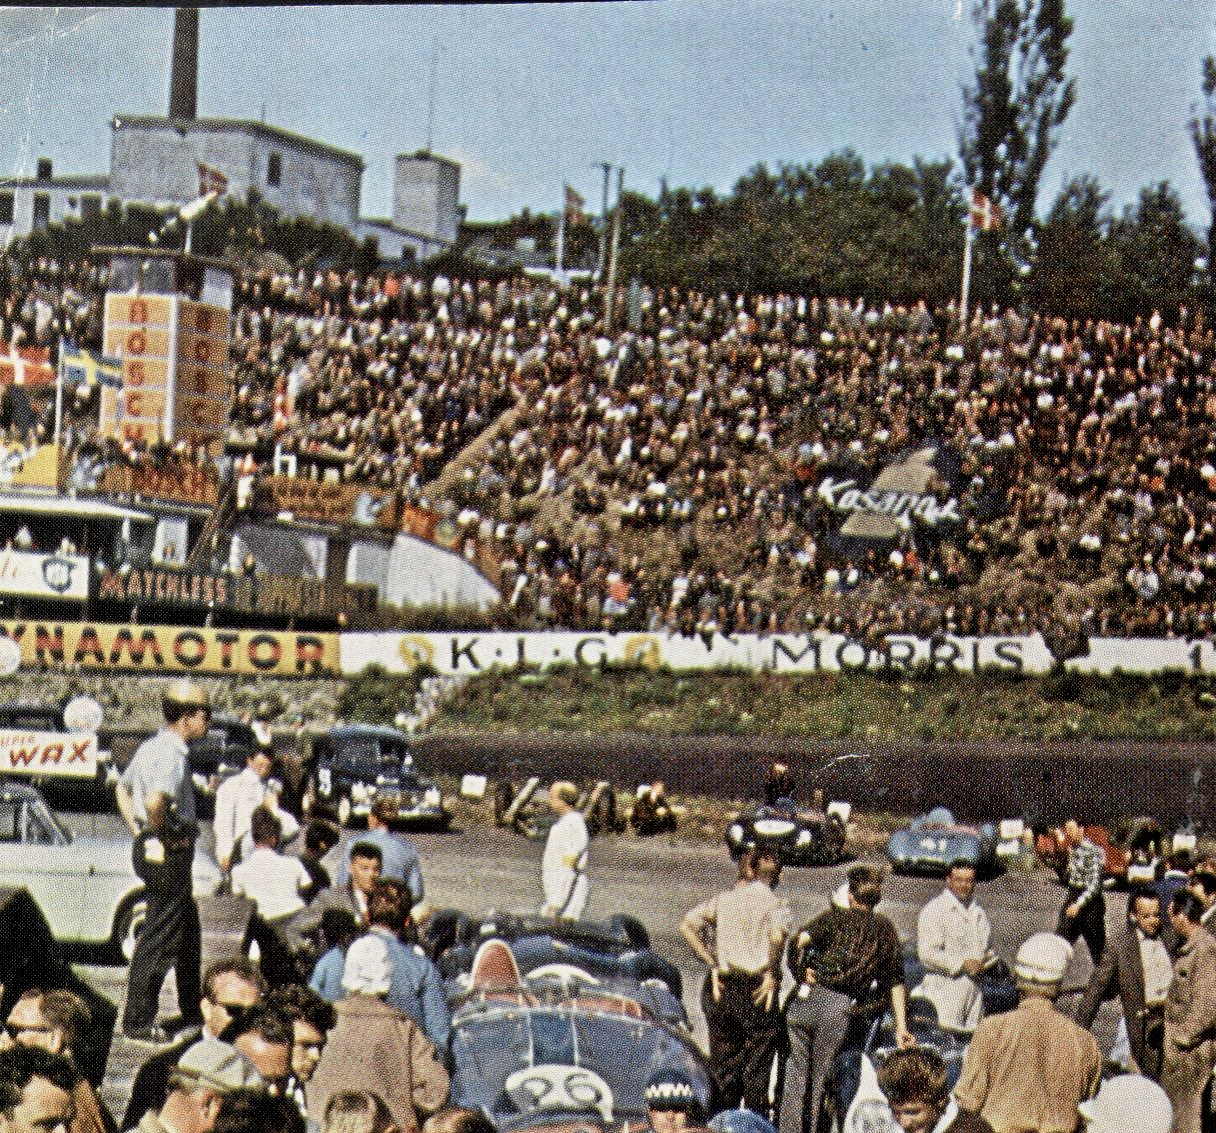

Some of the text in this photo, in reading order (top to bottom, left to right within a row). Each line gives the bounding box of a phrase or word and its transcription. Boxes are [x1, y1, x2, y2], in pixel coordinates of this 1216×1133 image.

[99, 567, 226, 602] MATCHLESS
[771, 637, 1024, 674] MORRIS
[9, 738, 92, 767] WAX
